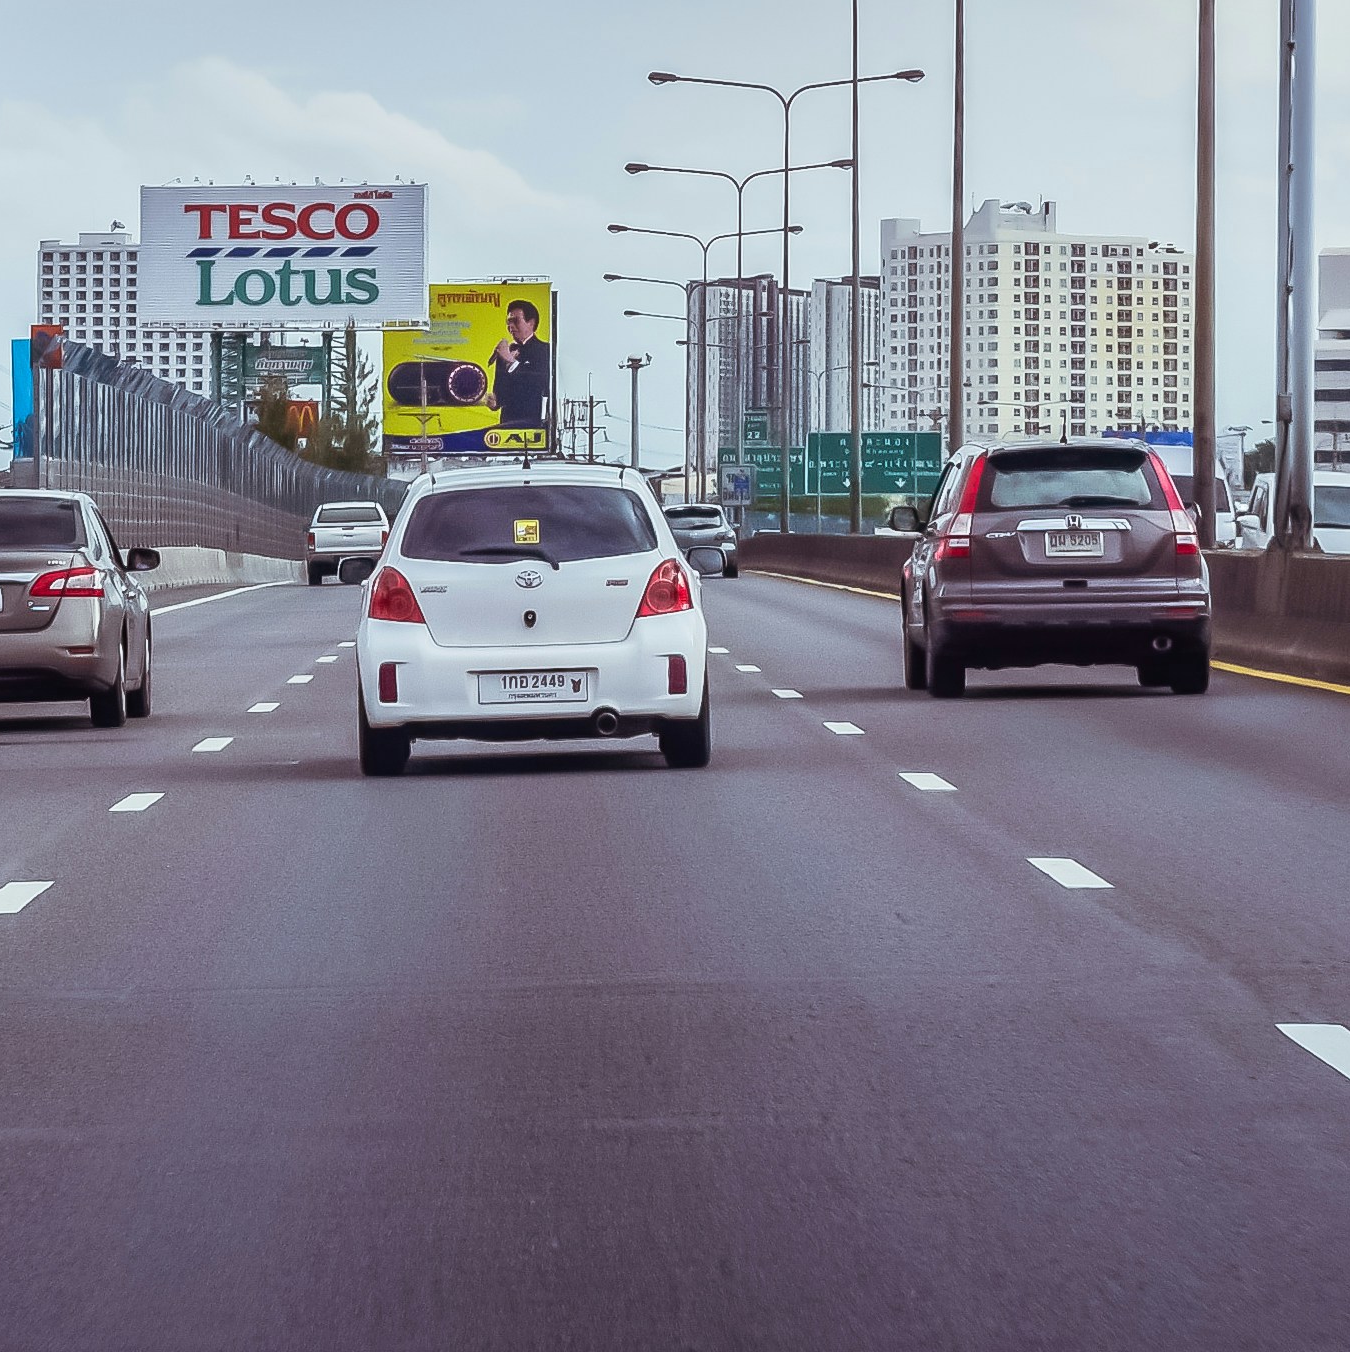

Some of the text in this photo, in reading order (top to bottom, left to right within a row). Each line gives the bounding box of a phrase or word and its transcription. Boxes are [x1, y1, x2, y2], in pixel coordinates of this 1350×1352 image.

[183, 202, 380, 241] TESCO
[195, 259, 380, 307] Lotus
[531, 674, 565, 689] 2449
